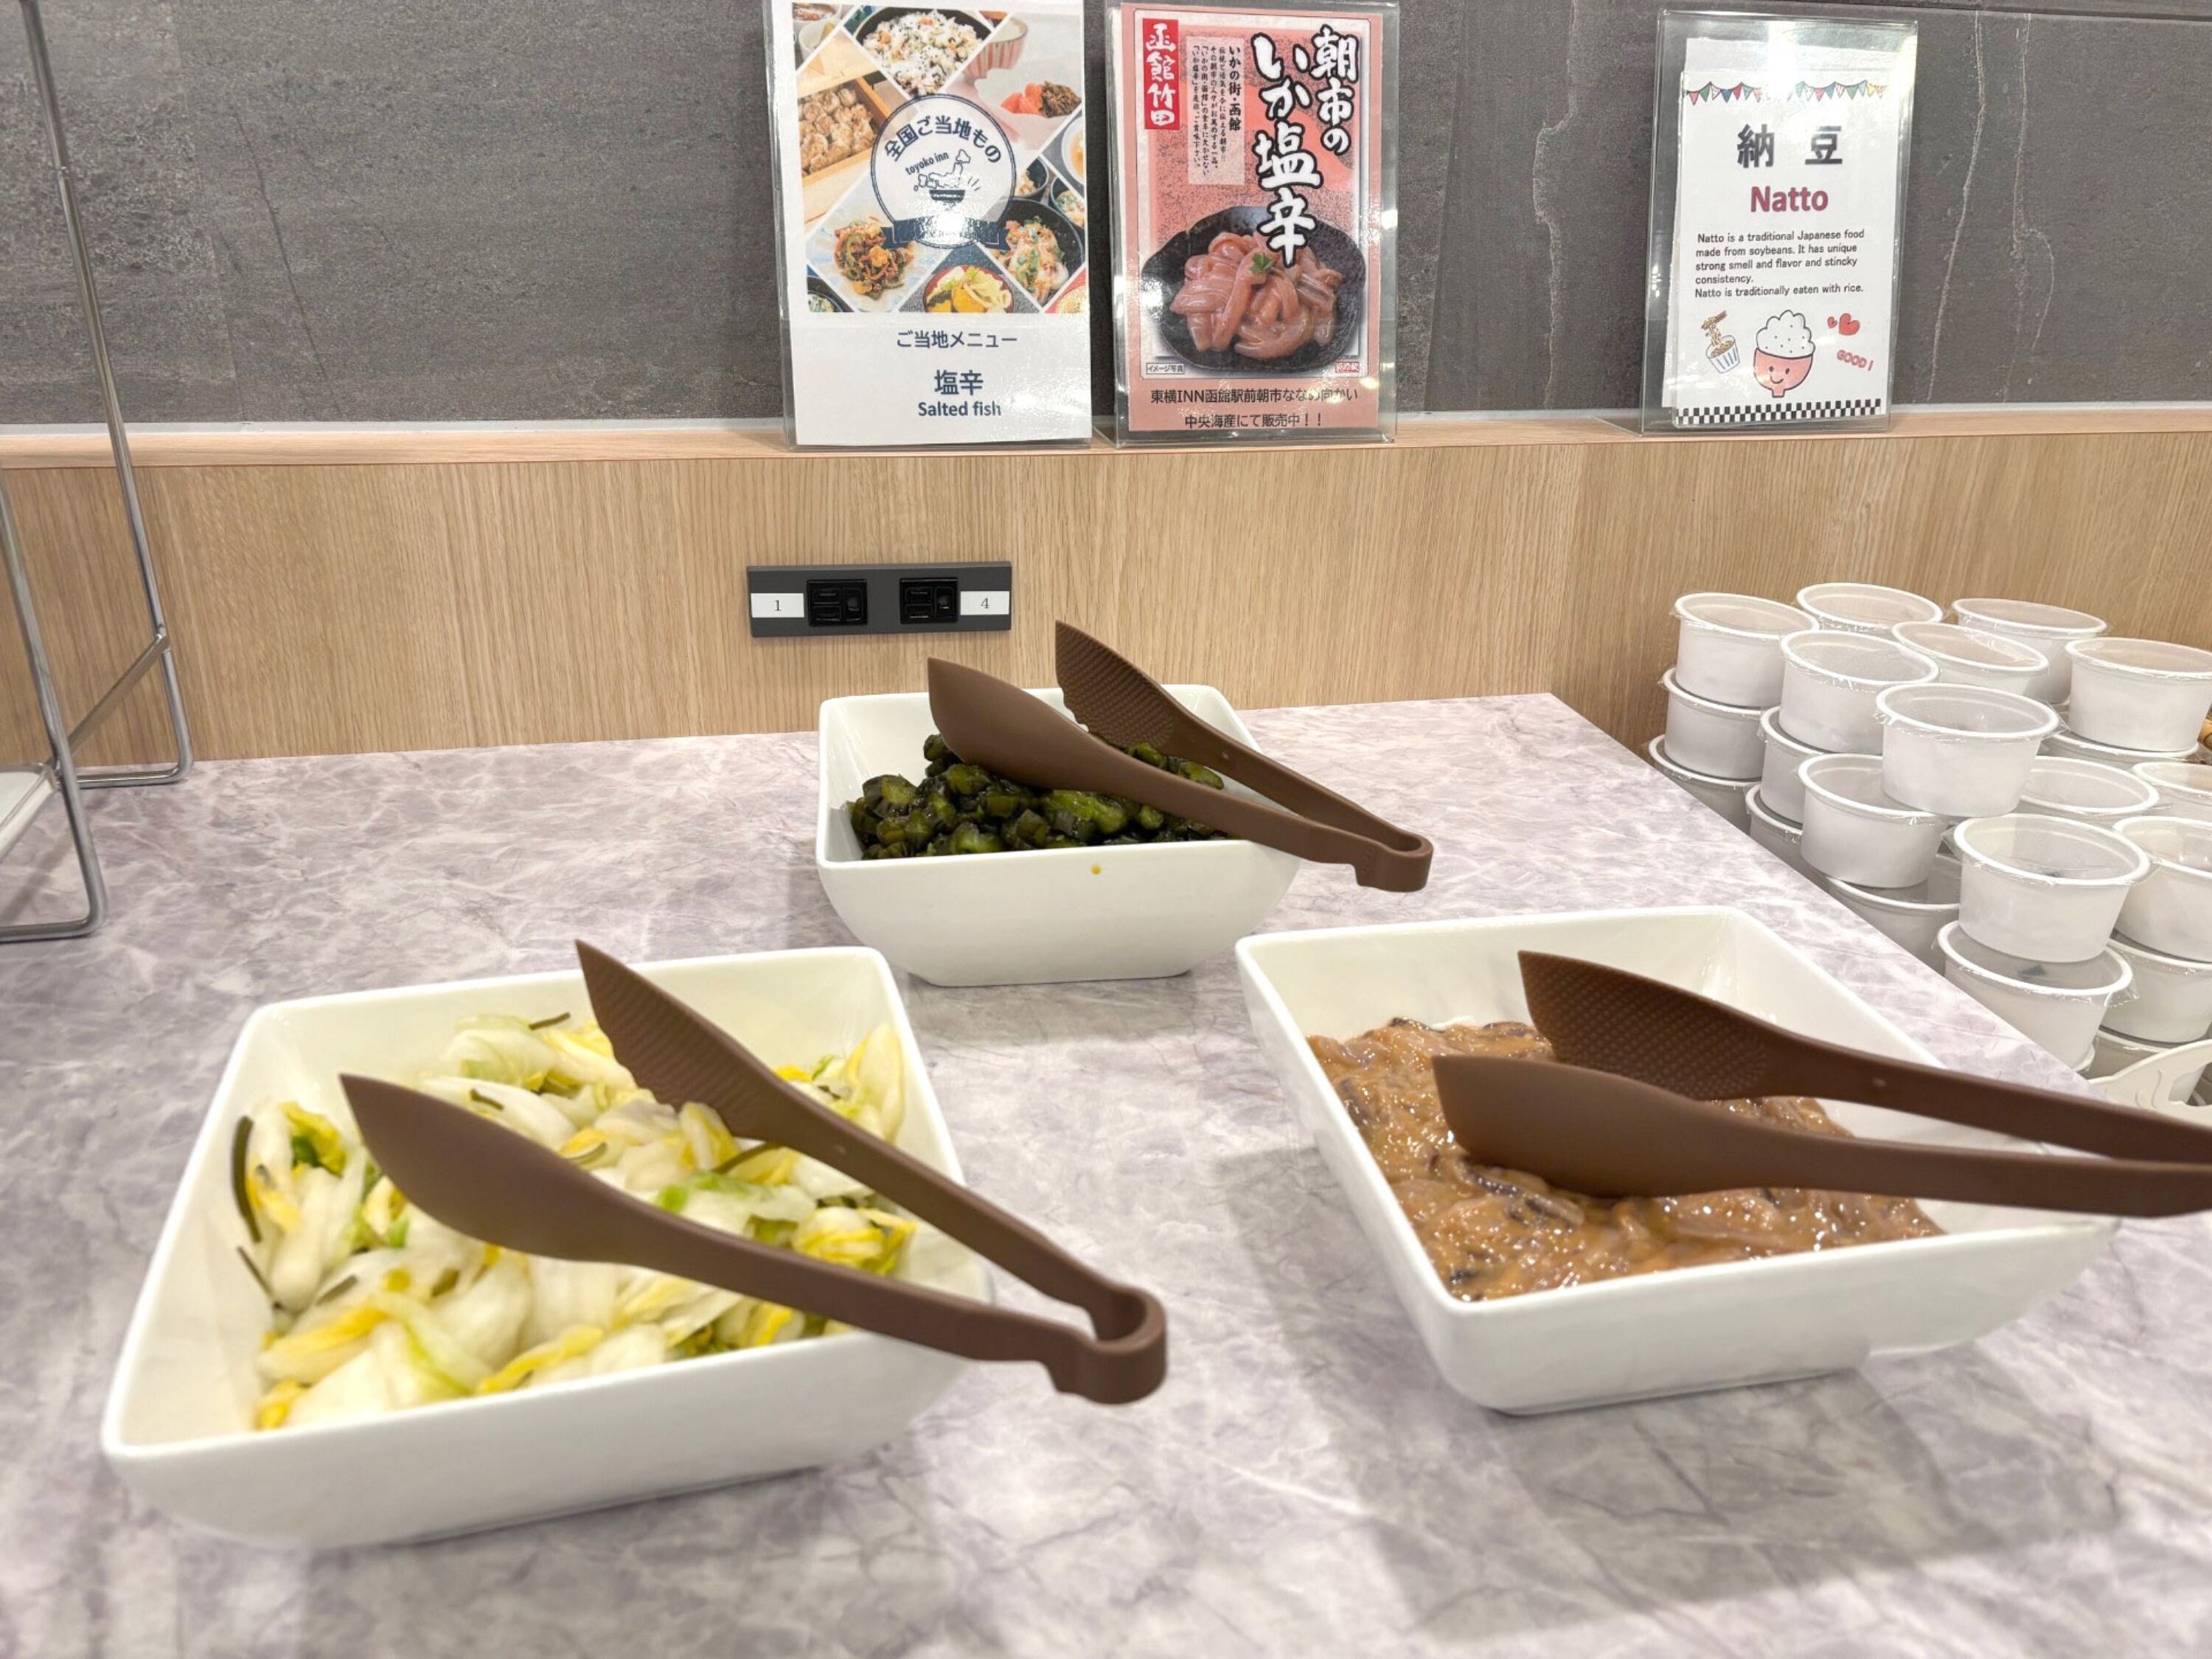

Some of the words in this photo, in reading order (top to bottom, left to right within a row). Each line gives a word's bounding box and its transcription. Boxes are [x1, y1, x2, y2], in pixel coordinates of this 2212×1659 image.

[1146, 23, 1177, 126] 函館竹田
[1228, 46, 1242, 131] いかの街・函館
[1310, 24, 1359, 155] 朝市の
[884, 115, 1002, 164] 全国ご当地もの
[1251, 33, 1324, 268] いか塩辛
[905, 156, 934, 175] toyoko
[935, 151, 950, 163] inn
[1750, 186, 1829, 212] Natto
[1697, 234, 1725, 243] Natto
[1728, 232, 1736, 242] is
[1747, 230, 1795, 241] traditional
[1798, 230, 1842, 241] Japanese
[1844, 229, 1865, 238] food
[1695, 247, 1721, 257] made
[1725, 246, 1746, 256] from
[1749, 245, 1795, 256] soybeans.
[1798, 244, 1806, 254] It
[1808, 244, 1824, 253] has
[1827, 243, 1857, 254] unique
[1695, 262, 1726, 271] strong
[1729, 259, 1753, 269] smell
[1756, 258, 1773, 268] and
[1775, 257, 1802, 268] flavor
[1805, 257, 1822, 266] and
[1825, 256, 1858, 267] stincky
[1695, 274, 1754, 284] consistency.
[1695, 288, 1722, 297] Natto
[1725, 287, 1732, 296] is
[1735, 285, 1790, 296] traditionally
[1793, 285, 1819, 294] eaten
[1822, 283, 1840, 293] with
[1844, 283, 1863, 293] rice.
[897, 330, 1018, 348] ご当地メニュー
[934, 369, 984, 396] 塩辛
[918, 400, 968, 417] Salted
[972, 401, 1001, 417] fish
[774, 599, 782, 611] 1
[980, 597, 990, 609] 4
